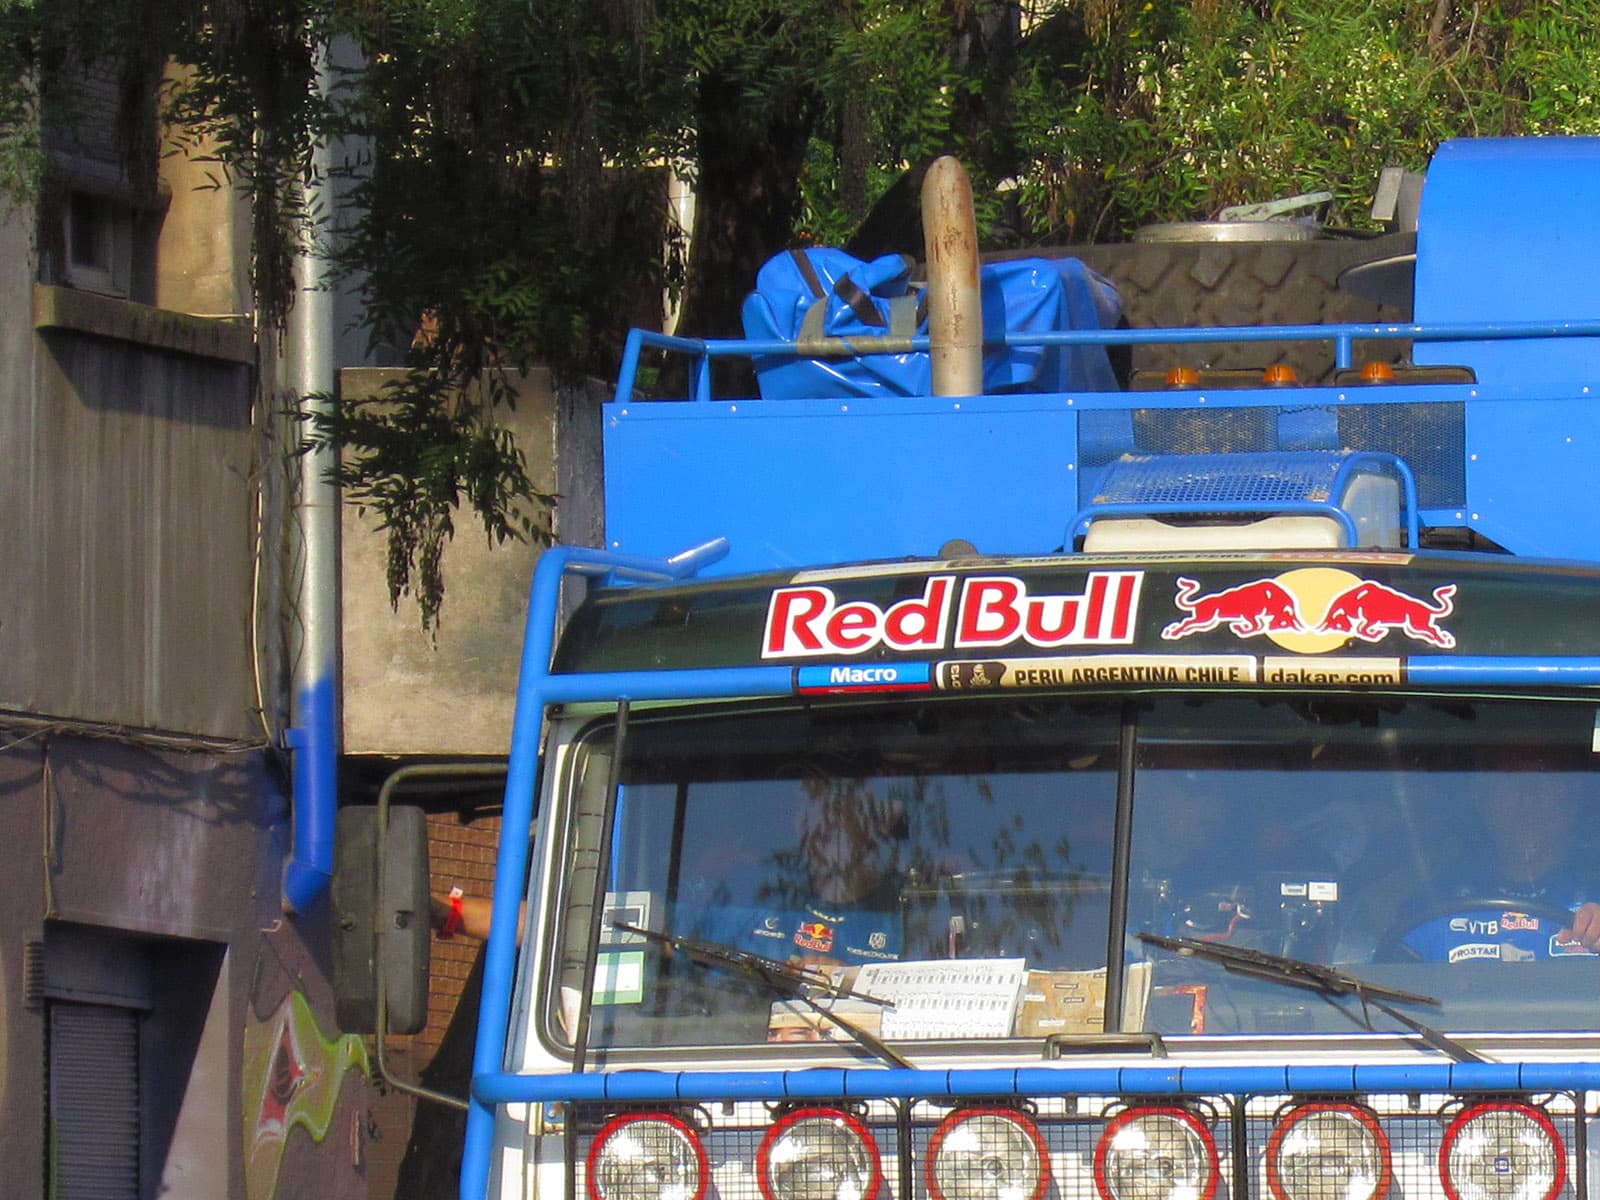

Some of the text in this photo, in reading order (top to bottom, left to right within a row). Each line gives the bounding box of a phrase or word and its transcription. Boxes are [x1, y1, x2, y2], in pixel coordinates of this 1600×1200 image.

[765, 572, 1139, 656] Red Bull
[830, 666, 897, 684] Macro
[1015, 665, 1240, 687] PERU ARGENTINA CHILE
[1270, 668, 1395, 685] dakar.com
[1467, 920, 1499, 936] VTB
